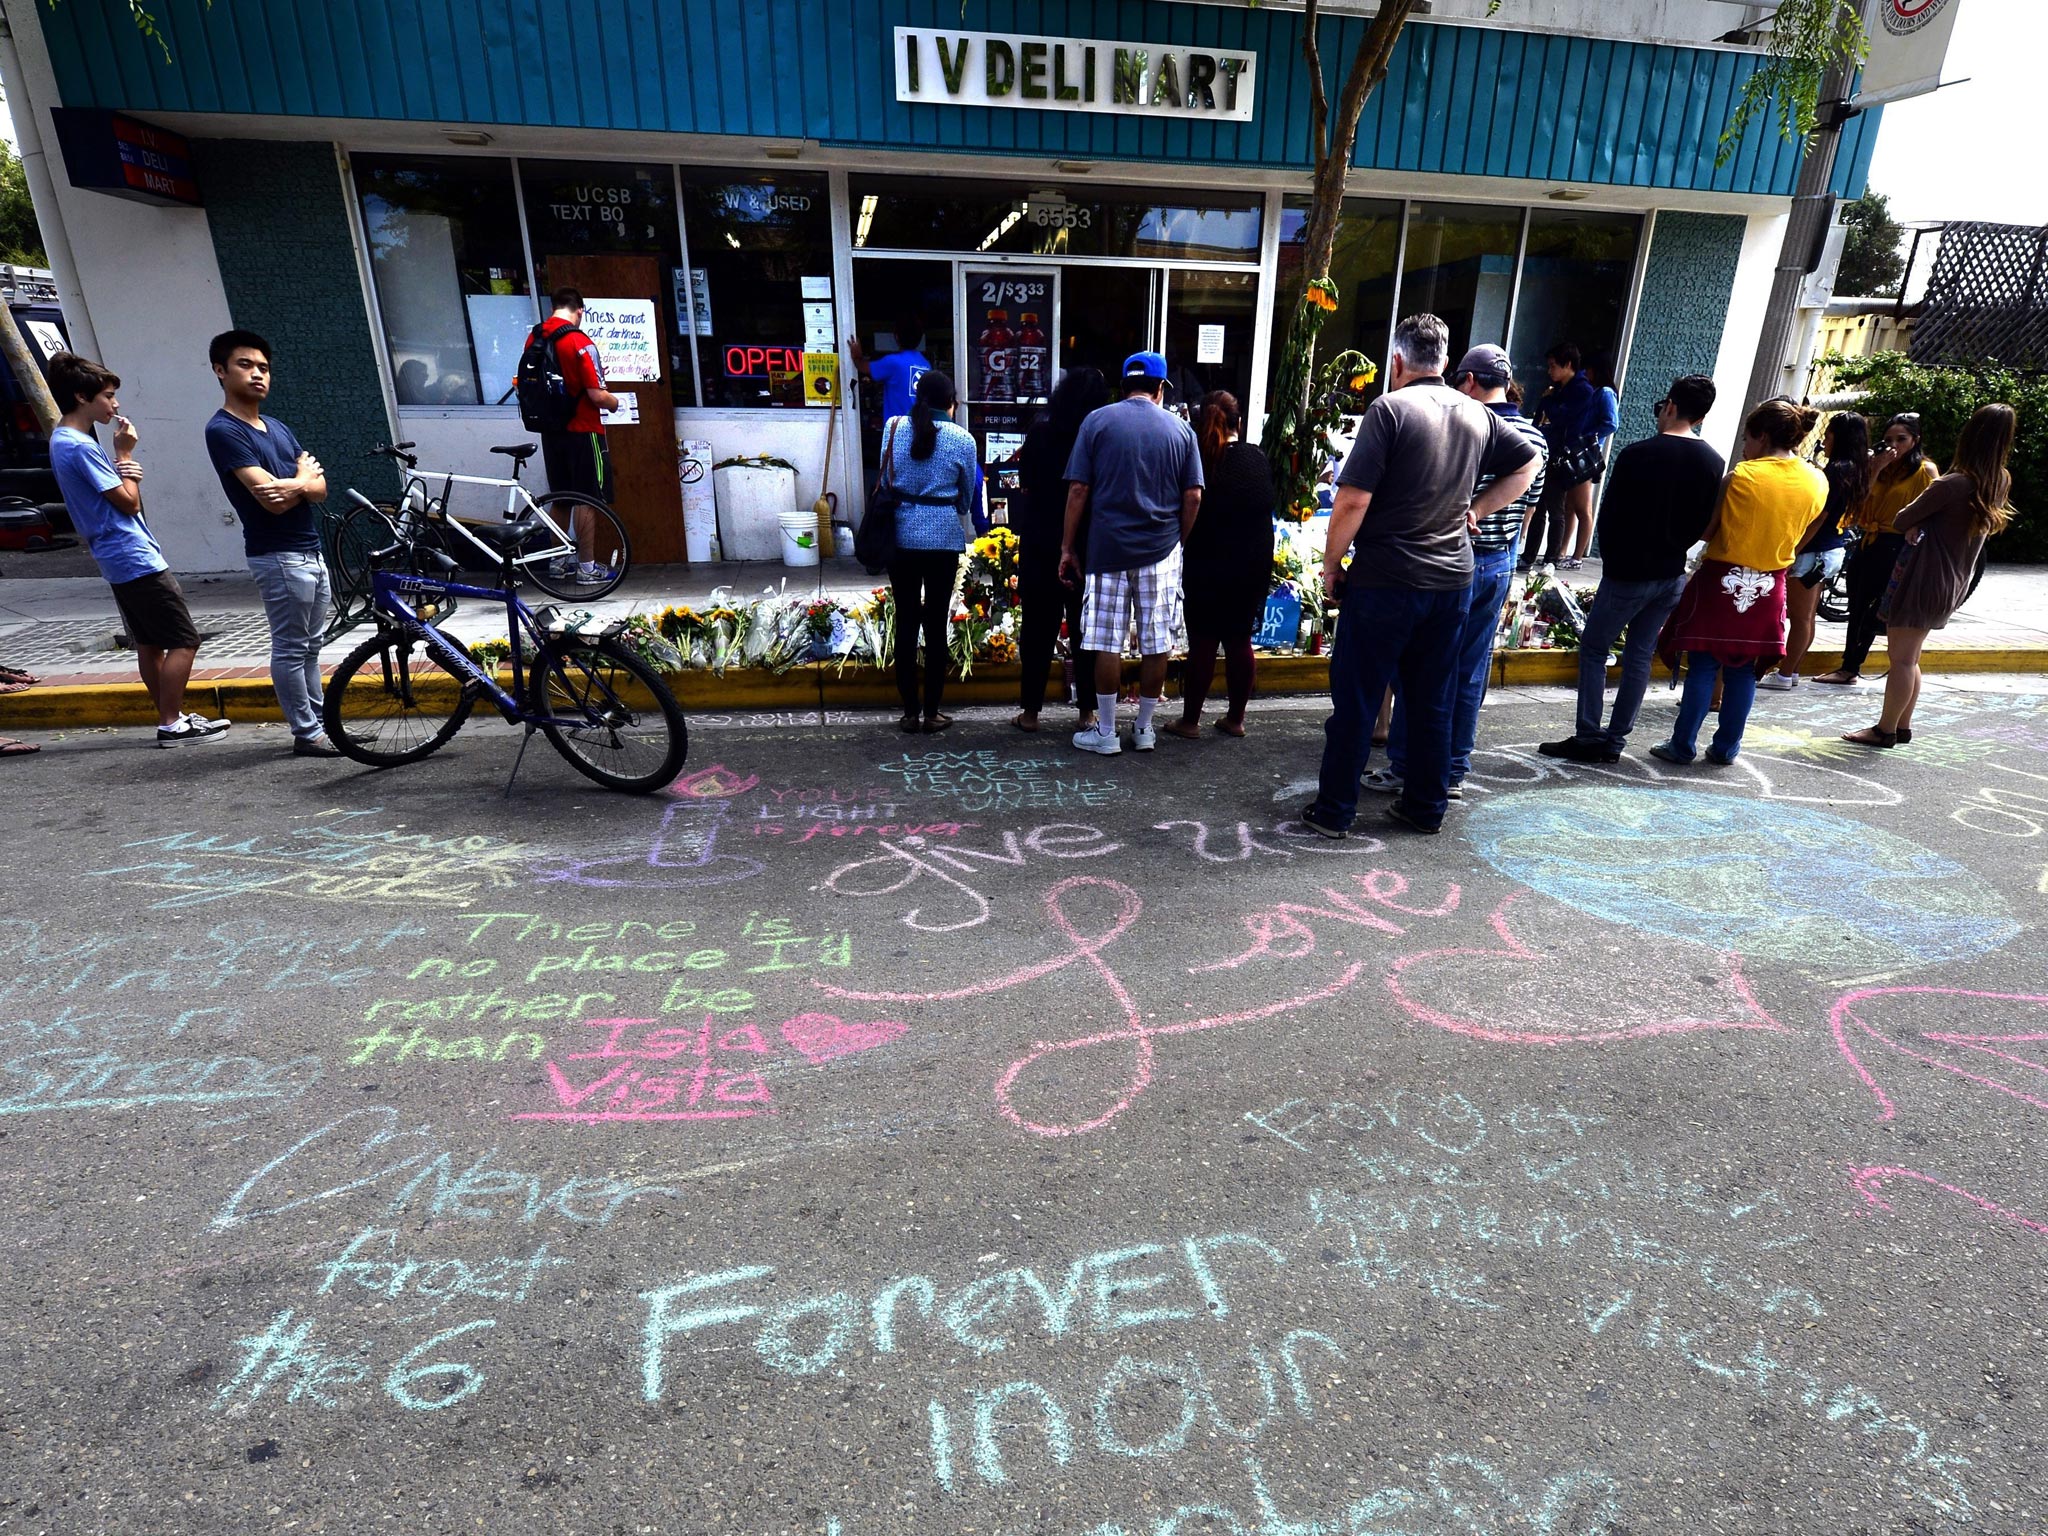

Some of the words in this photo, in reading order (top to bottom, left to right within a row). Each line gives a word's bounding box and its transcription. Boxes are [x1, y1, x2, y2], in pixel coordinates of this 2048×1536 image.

[985, 39, 1097, 104] DELI
[1112, 48, 1249, 112] MART
[142, 150, 169, 172] DELI
[144, 172, 176, 195] MART
[576, 187, 631, 204] UCSB
[749, 194, 761, 211] &
[769, 195, 811, 212] USED
[550, 204, 592, 221] TEXT
[1035, 207, 1091, 229] 6553
[727, 347, 803, 375] OPEN
[807, 364, 835, 373] SPIRIT
[988, 350, 1006, 371] G
[1020, 354, 1039, 370] G2
[1263, 605, 1285, 624] US
[903, 749, 997, 763] LOVE
[903, 769, 1043, 785] PEACE
[769, 787, 892, 802] YOUR
[753, 802, 909, 820] LIGHT
[786, 820, 982, 844] forever
[1152, 819, 1387, 863] us
[457, 911, 697, 945] There
[740, 909, 795, 942] is
[406, 953, 499, 981] no
[525, 944, 731, 984] place
[744, 928, 853, 975] I'd
[363, 986, 616, 1024] rather
[658, 977, 758, 1015] be
[347, 1024, 547, 1068] than
[567, 1014, 773, 1061] Isla
[546, 1055, 773, 1112] Vista
[209, 1307, 373, 1412] the
[383, 1318, 496, 1413] 6
